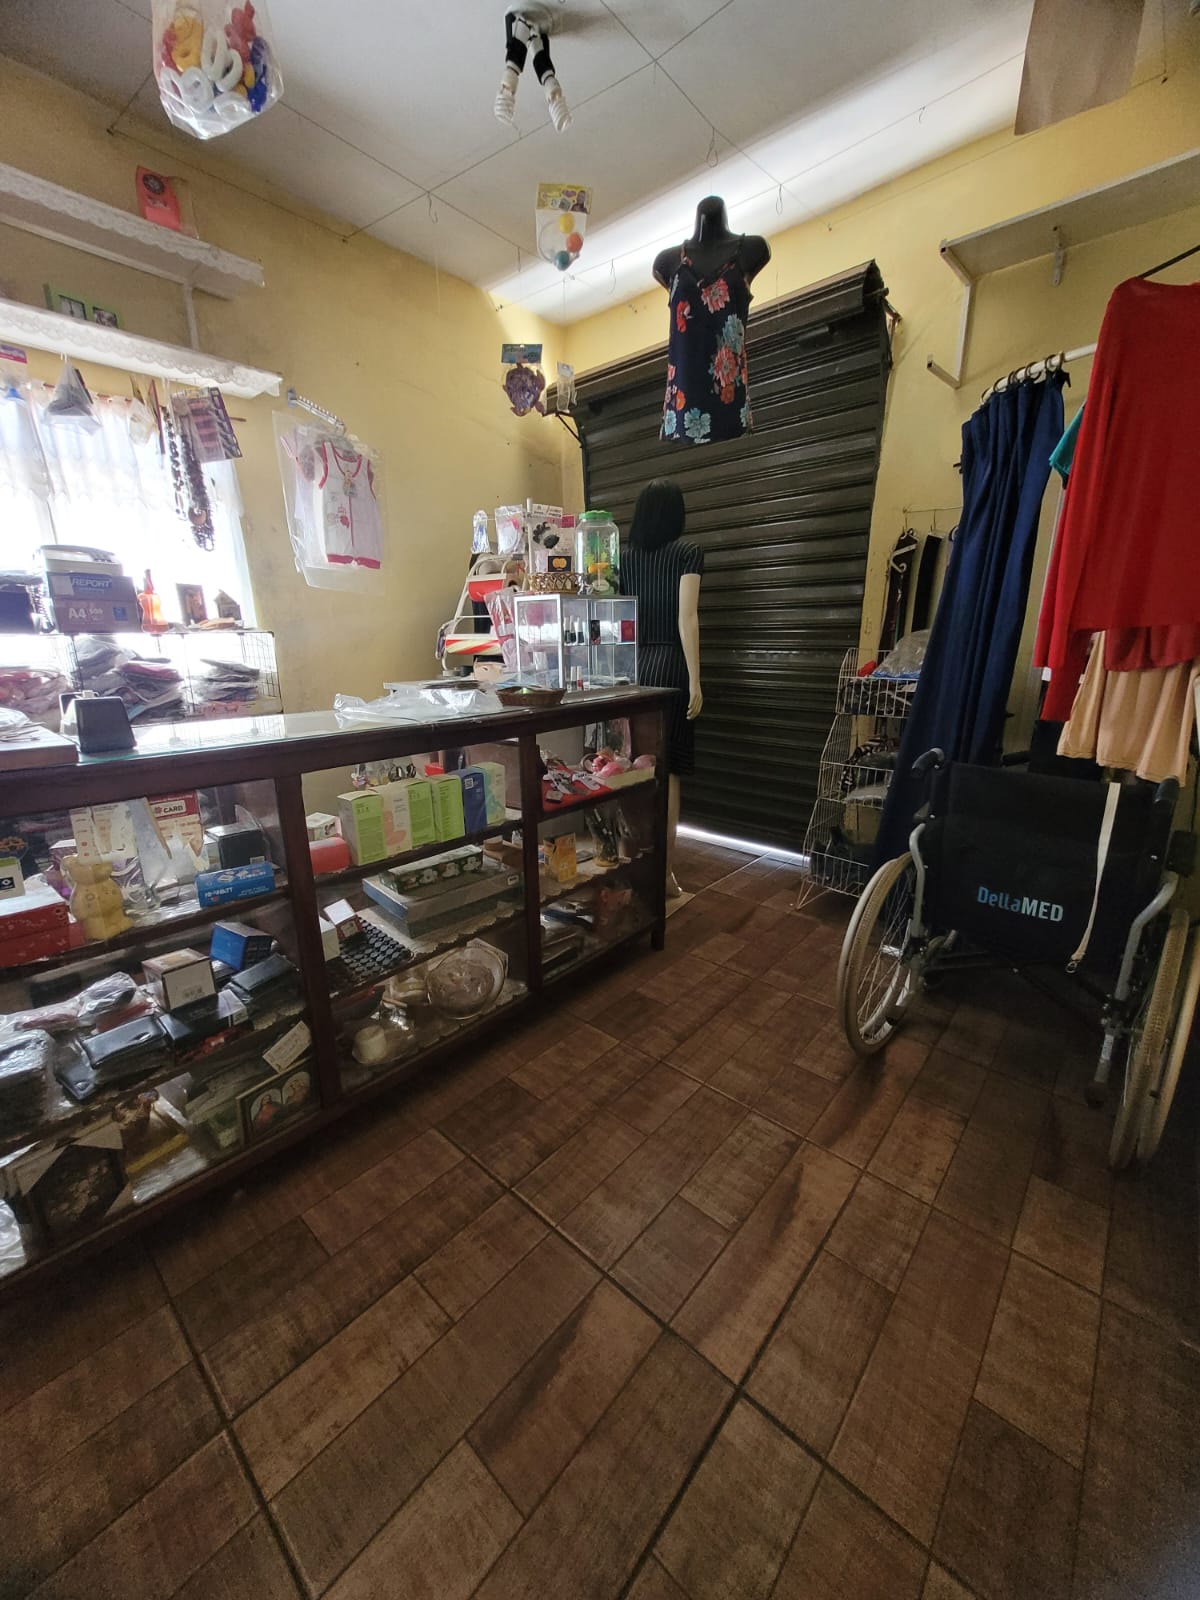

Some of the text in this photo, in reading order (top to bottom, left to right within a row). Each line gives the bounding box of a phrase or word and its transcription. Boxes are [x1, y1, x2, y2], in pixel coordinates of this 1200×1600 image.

[72, 577, 111, 588] REPORT
[68, 607, 87, 620] A4
[163, 805, 184, 813] CARD
[976, 886, 1065, 922] DellaMED
